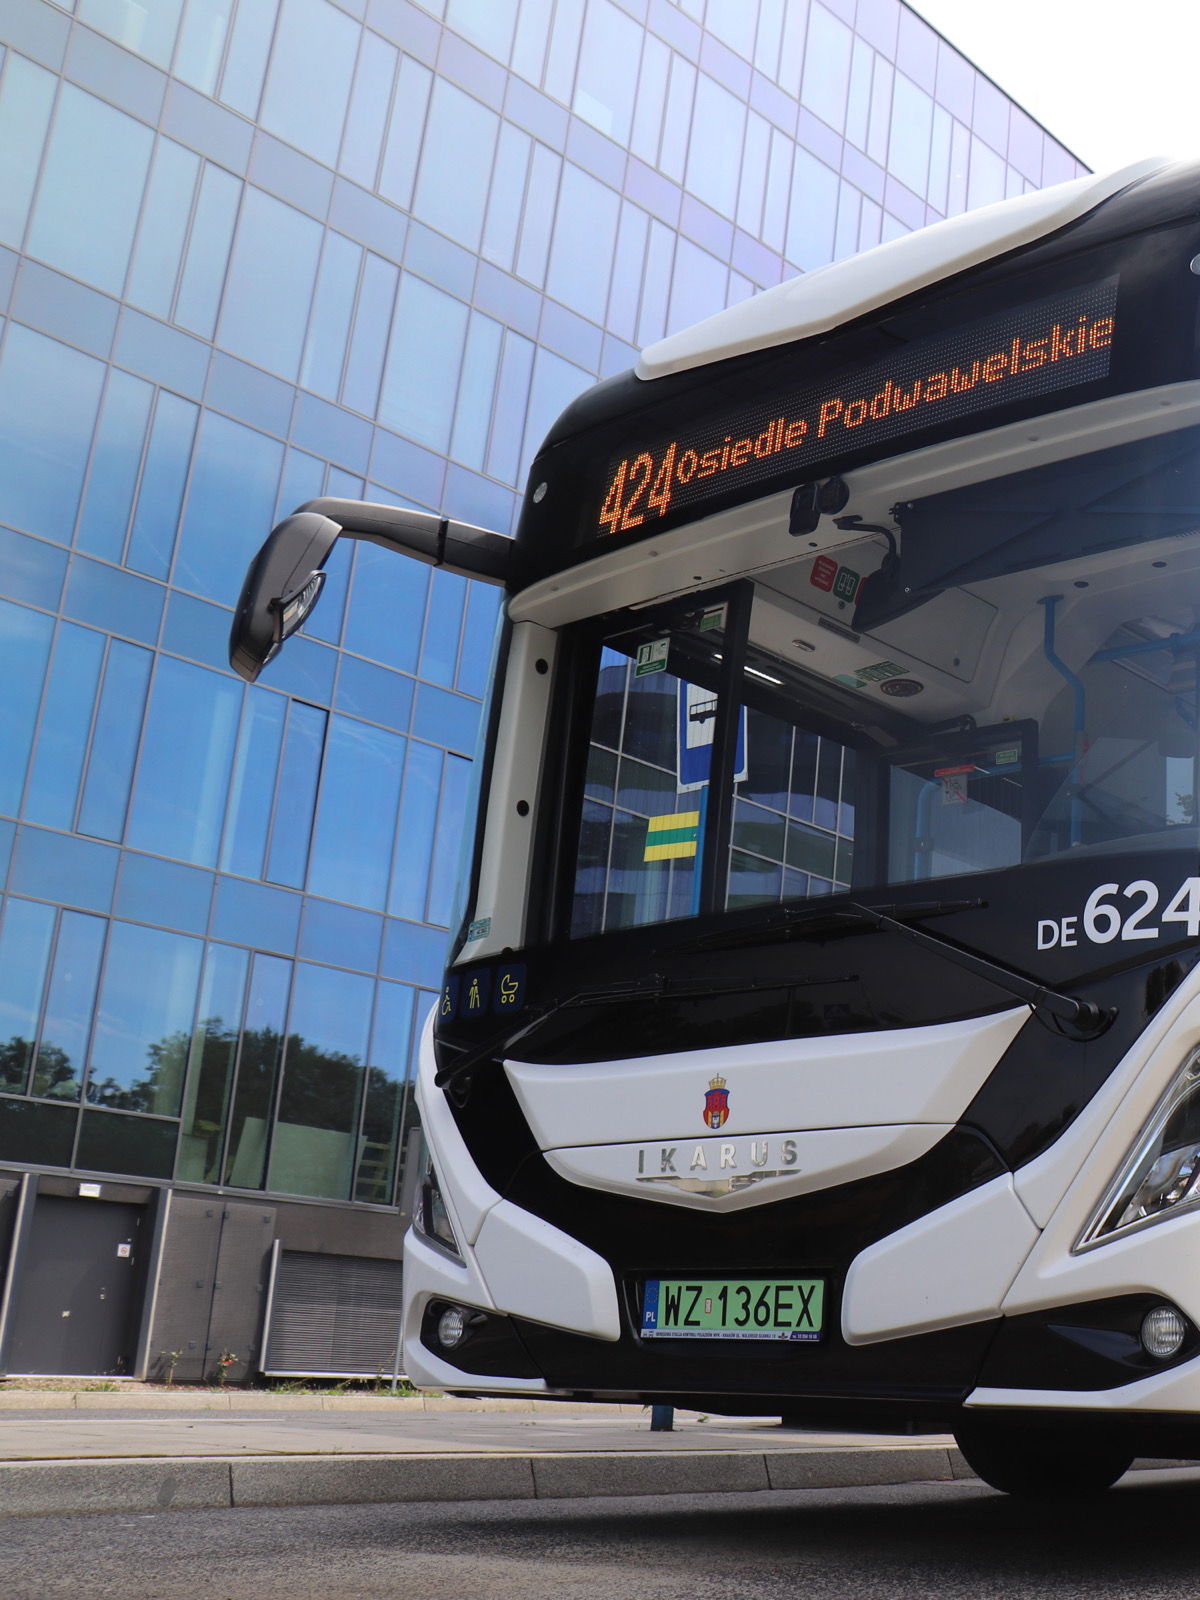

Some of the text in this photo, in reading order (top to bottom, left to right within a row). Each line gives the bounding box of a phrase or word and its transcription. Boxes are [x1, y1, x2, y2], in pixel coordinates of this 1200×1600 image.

[599, 315, 1115, 534] 424 Osiedle Podwawelskie
[1037, 916, 1078, 950] DE
[638, 1140, 798, 1174] IKARUS
[645, 1311, 656, 1323] PL
[664, 1285, 816, 1327] WZ 136EX
